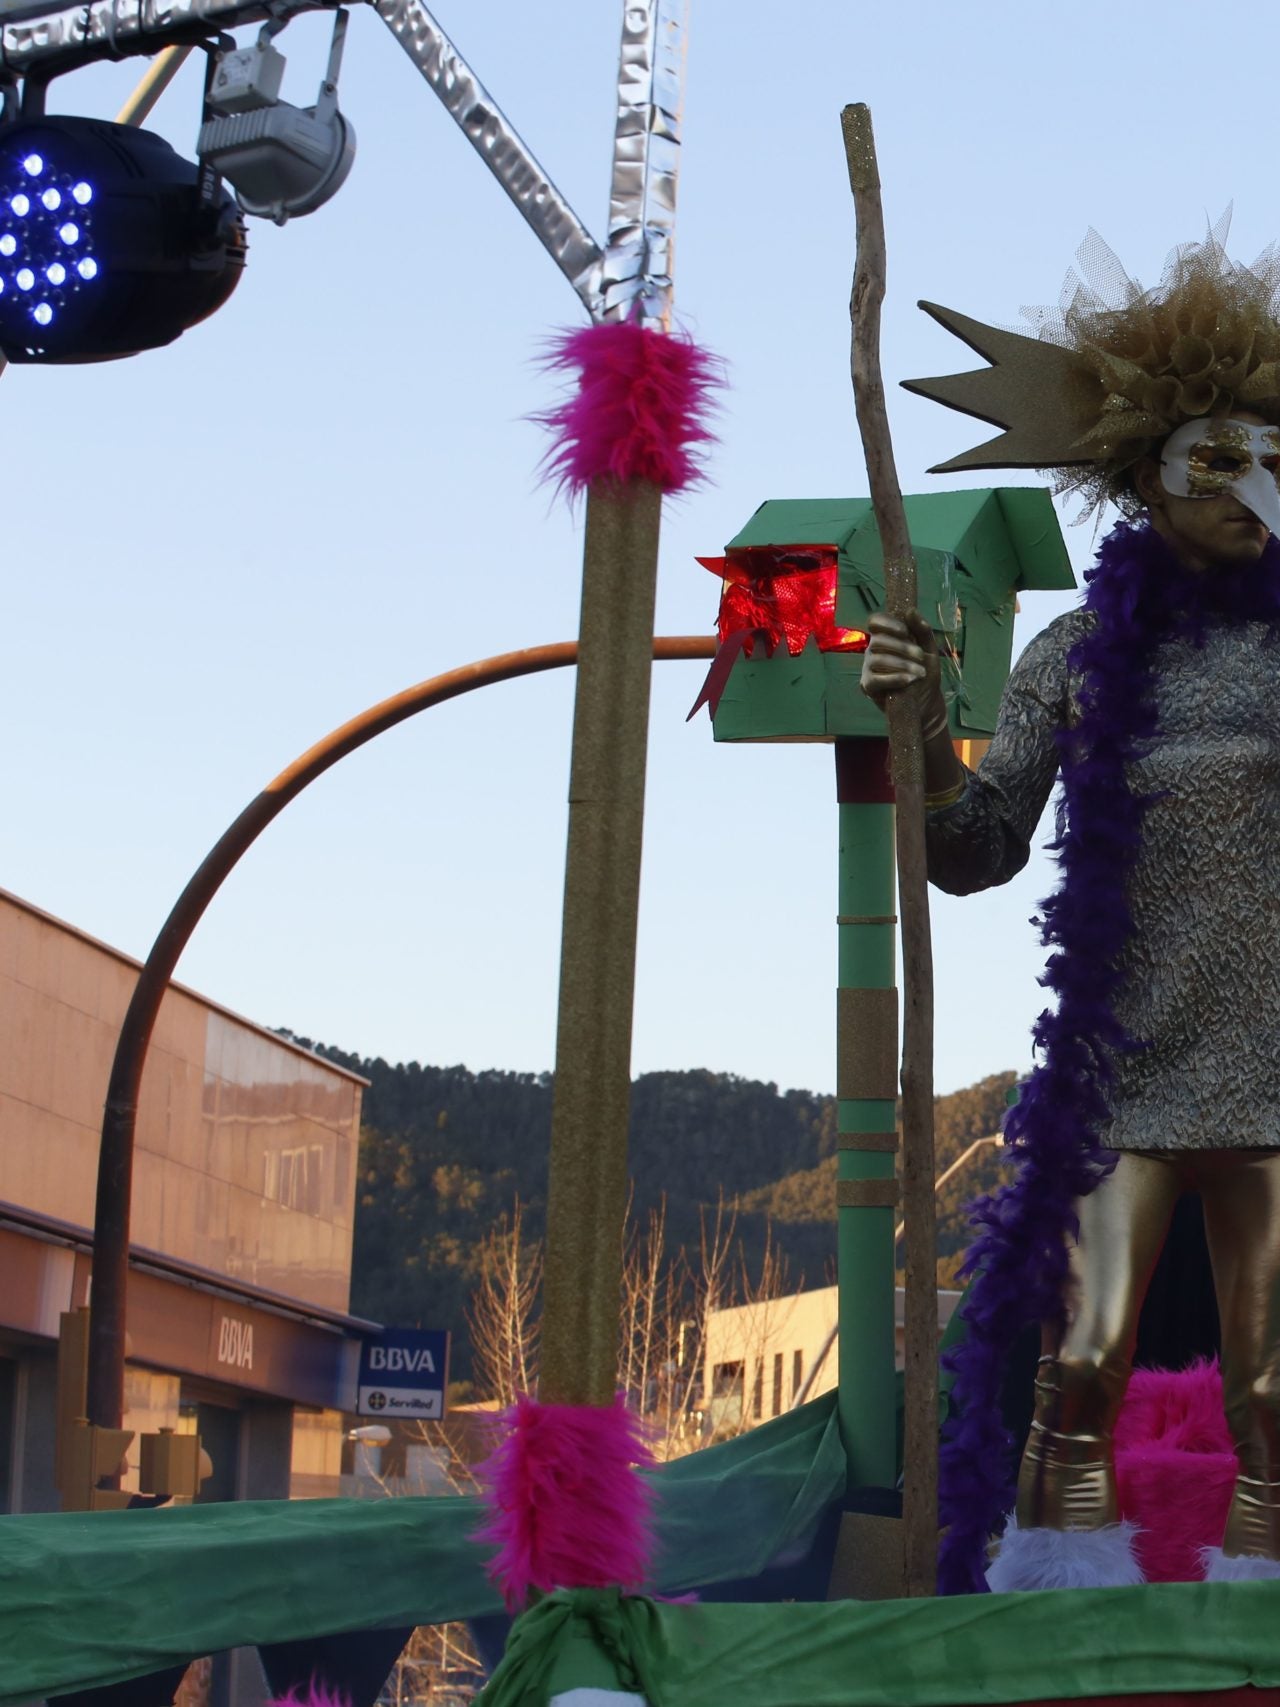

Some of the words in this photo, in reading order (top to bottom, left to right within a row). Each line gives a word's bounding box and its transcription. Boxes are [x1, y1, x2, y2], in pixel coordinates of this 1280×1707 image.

[218, 1316, 253, 1370] BBVA
[369, 1346, 436, 1373] BBVA
[388, 1398, 434, 1409] ServiRed
